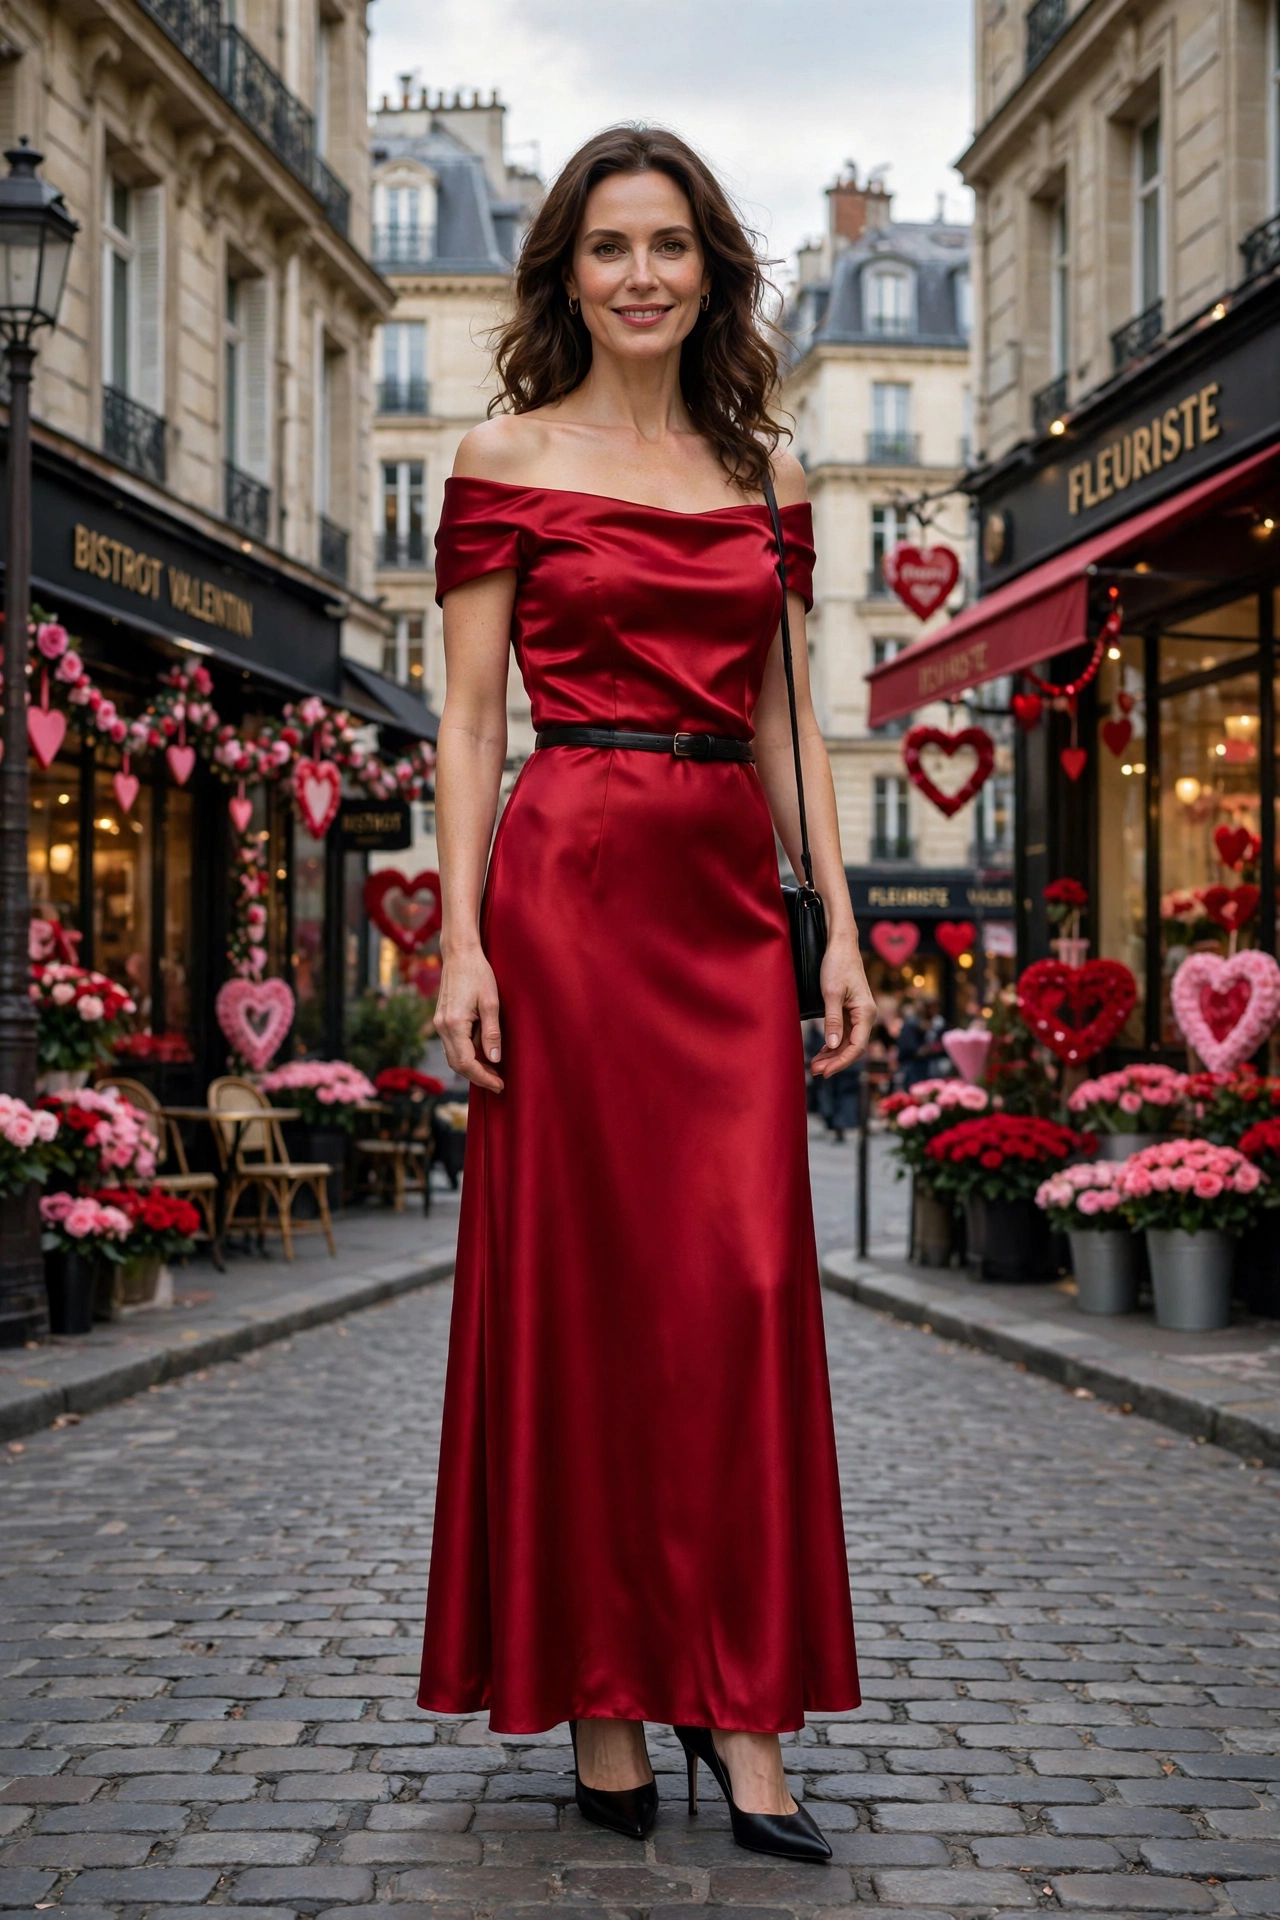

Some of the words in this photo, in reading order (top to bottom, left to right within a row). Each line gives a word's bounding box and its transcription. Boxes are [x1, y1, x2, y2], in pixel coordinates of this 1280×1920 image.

[1068, 381, 1220, 515] FLEURISTE
[74, 523, 164, 600] BISTROT
[168, 566, 253, 639] VALENTIN
[868, 886, 949, 907] FLEURISTE
